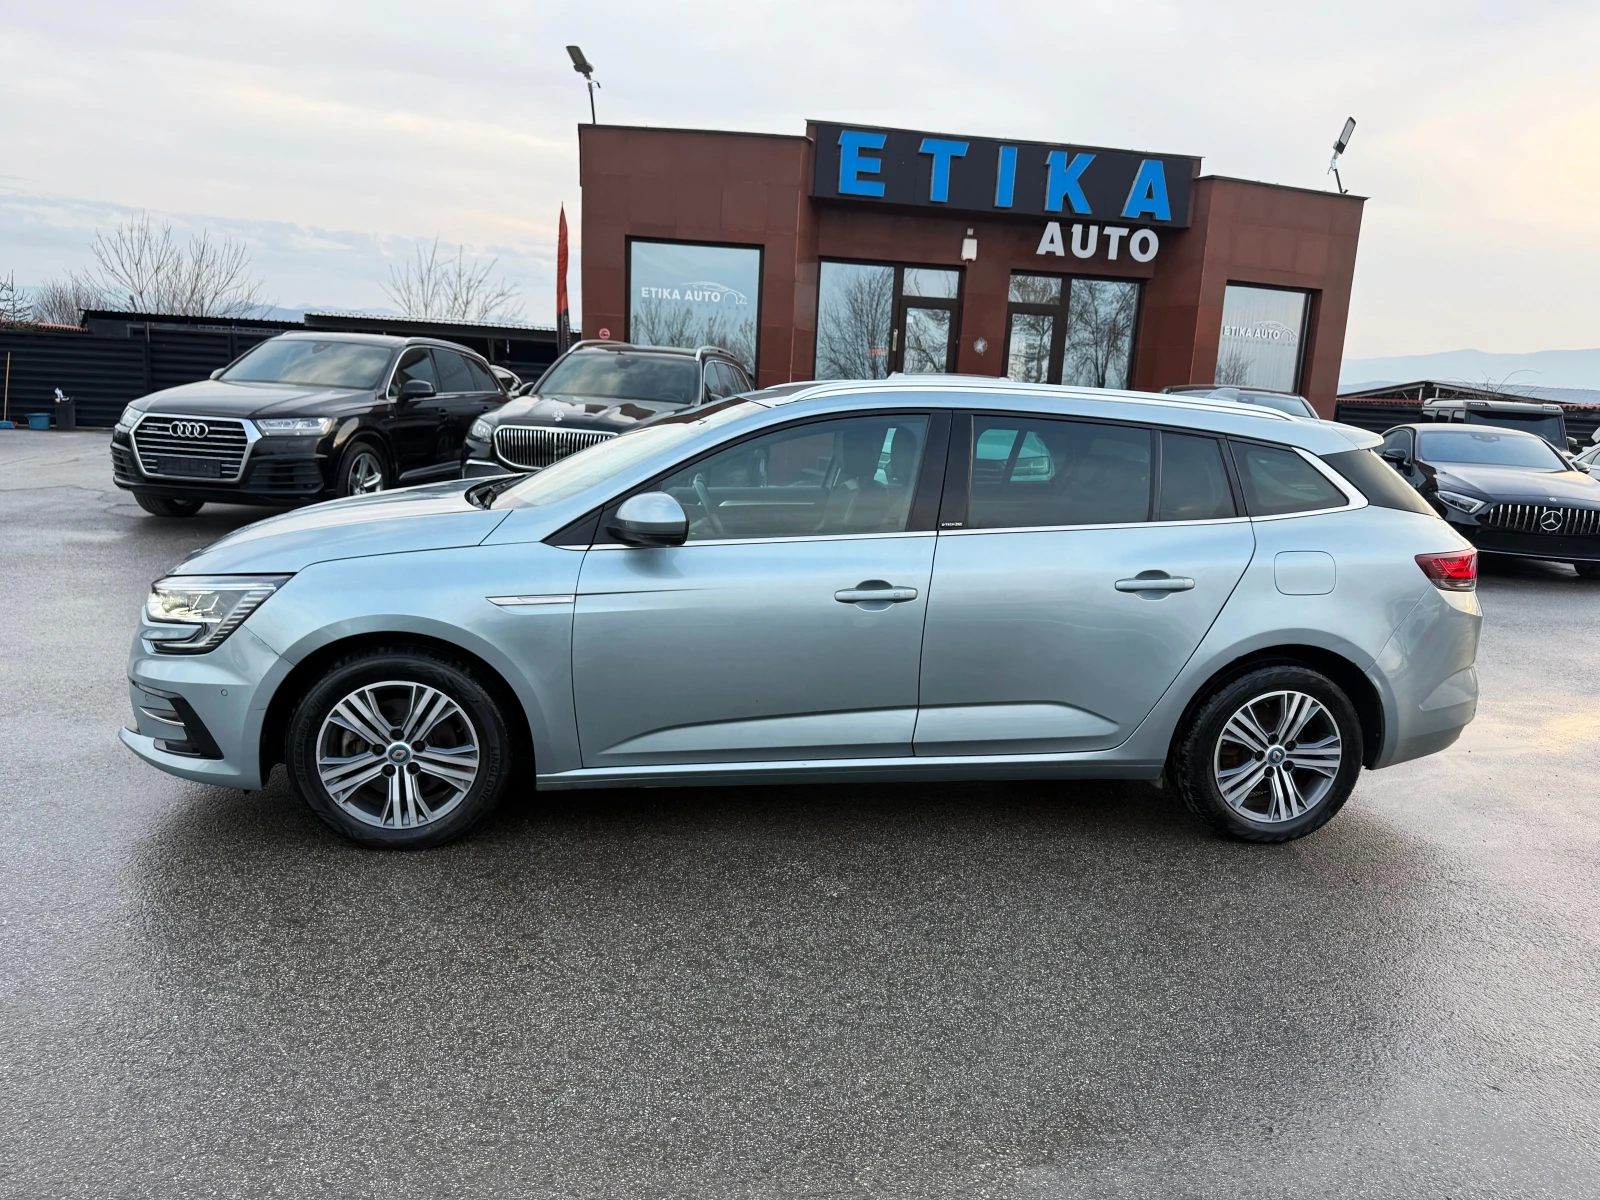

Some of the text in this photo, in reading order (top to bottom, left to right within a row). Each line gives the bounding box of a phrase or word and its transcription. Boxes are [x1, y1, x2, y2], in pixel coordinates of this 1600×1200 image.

[838, 130, 1171, 221] ETIKA
[1036, 221, 1159, 263] AUTO
[641, 287, 720, 303] ETIKA AUTO
[1223, 325, 1280, 340] ETIKA AUTO
[478, 746, 500, 802] LINGLONG
